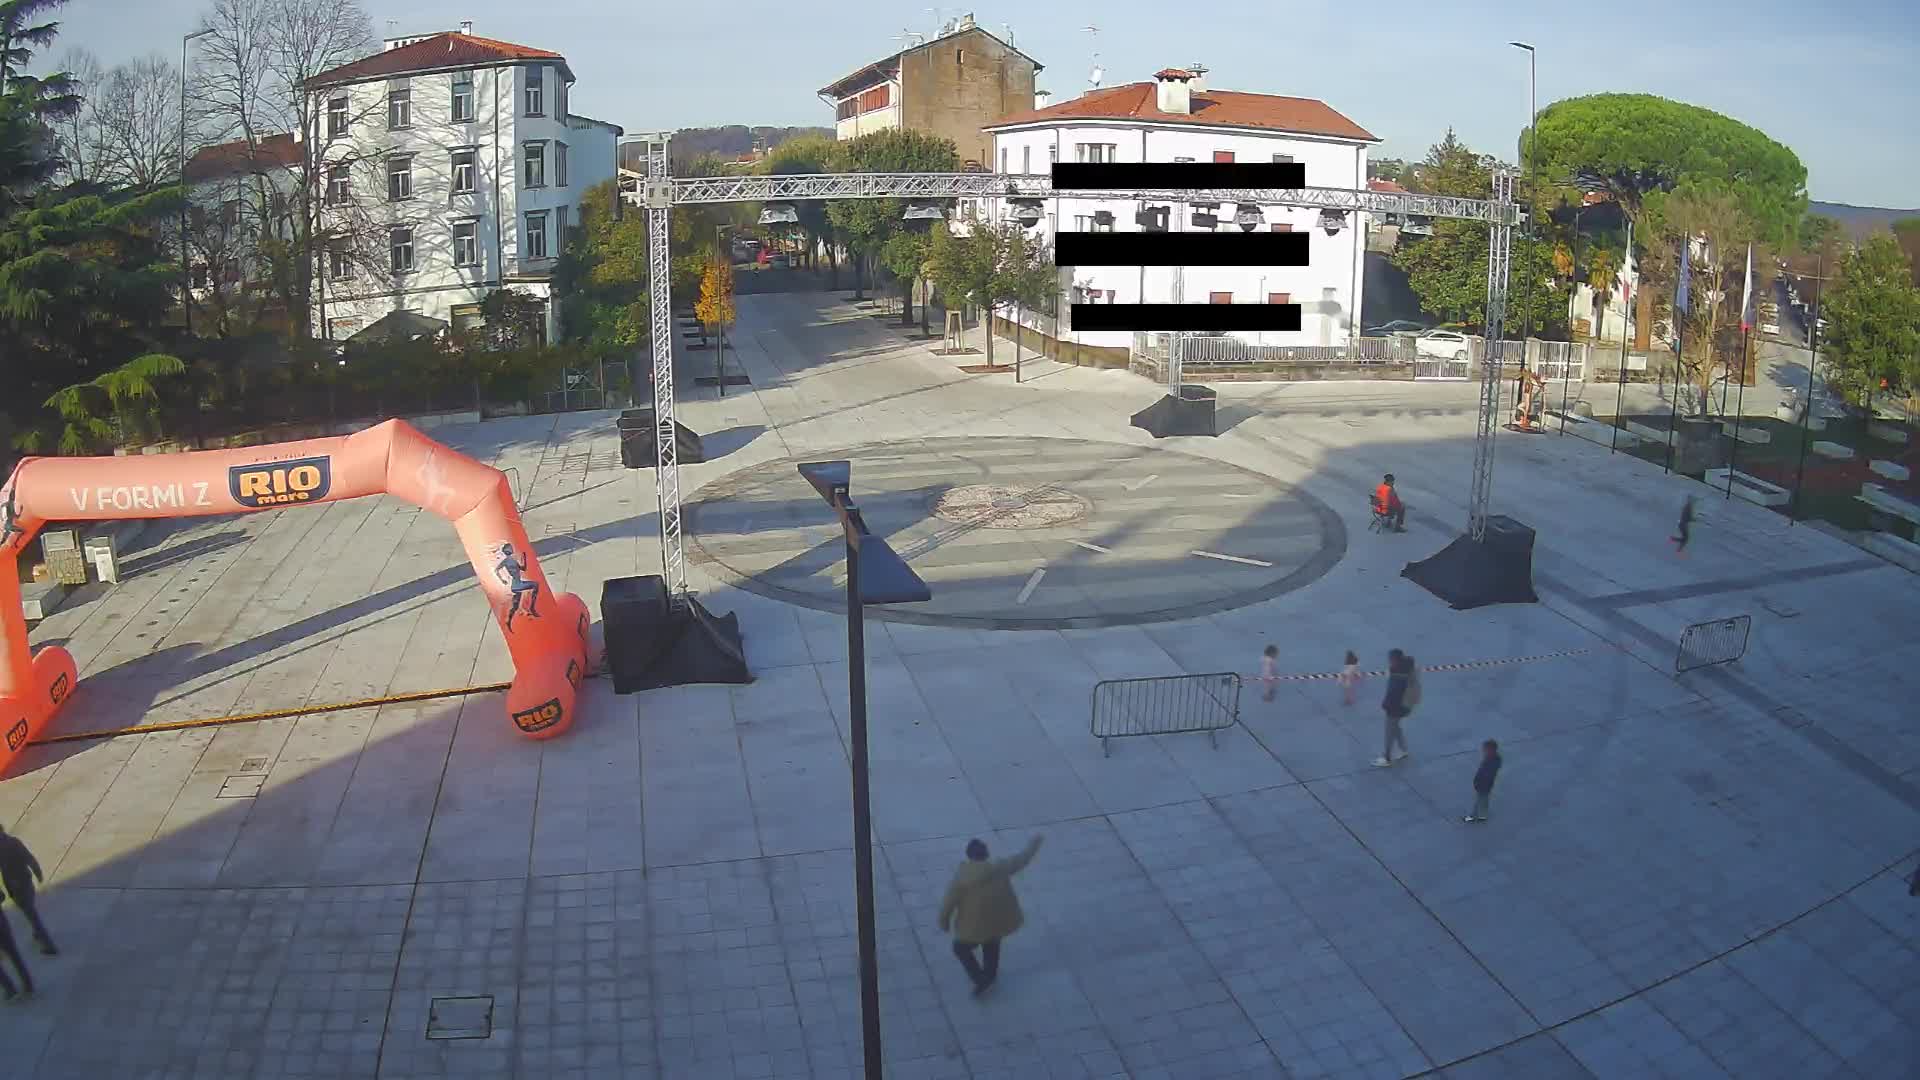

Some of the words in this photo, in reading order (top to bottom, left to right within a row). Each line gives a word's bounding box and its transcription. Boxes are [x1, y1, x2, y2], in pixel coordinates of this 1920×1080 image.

[239, 465, 321, 497] RIO
[70, 488, 89, 511] V
[97, 483, 185, 510] FORMI
[192, 482, 212, 506] Z
[256, 491, 310, 505] mare
[518, 704, 559, 727] RIO
[9, 723, 27, 745] RIO
